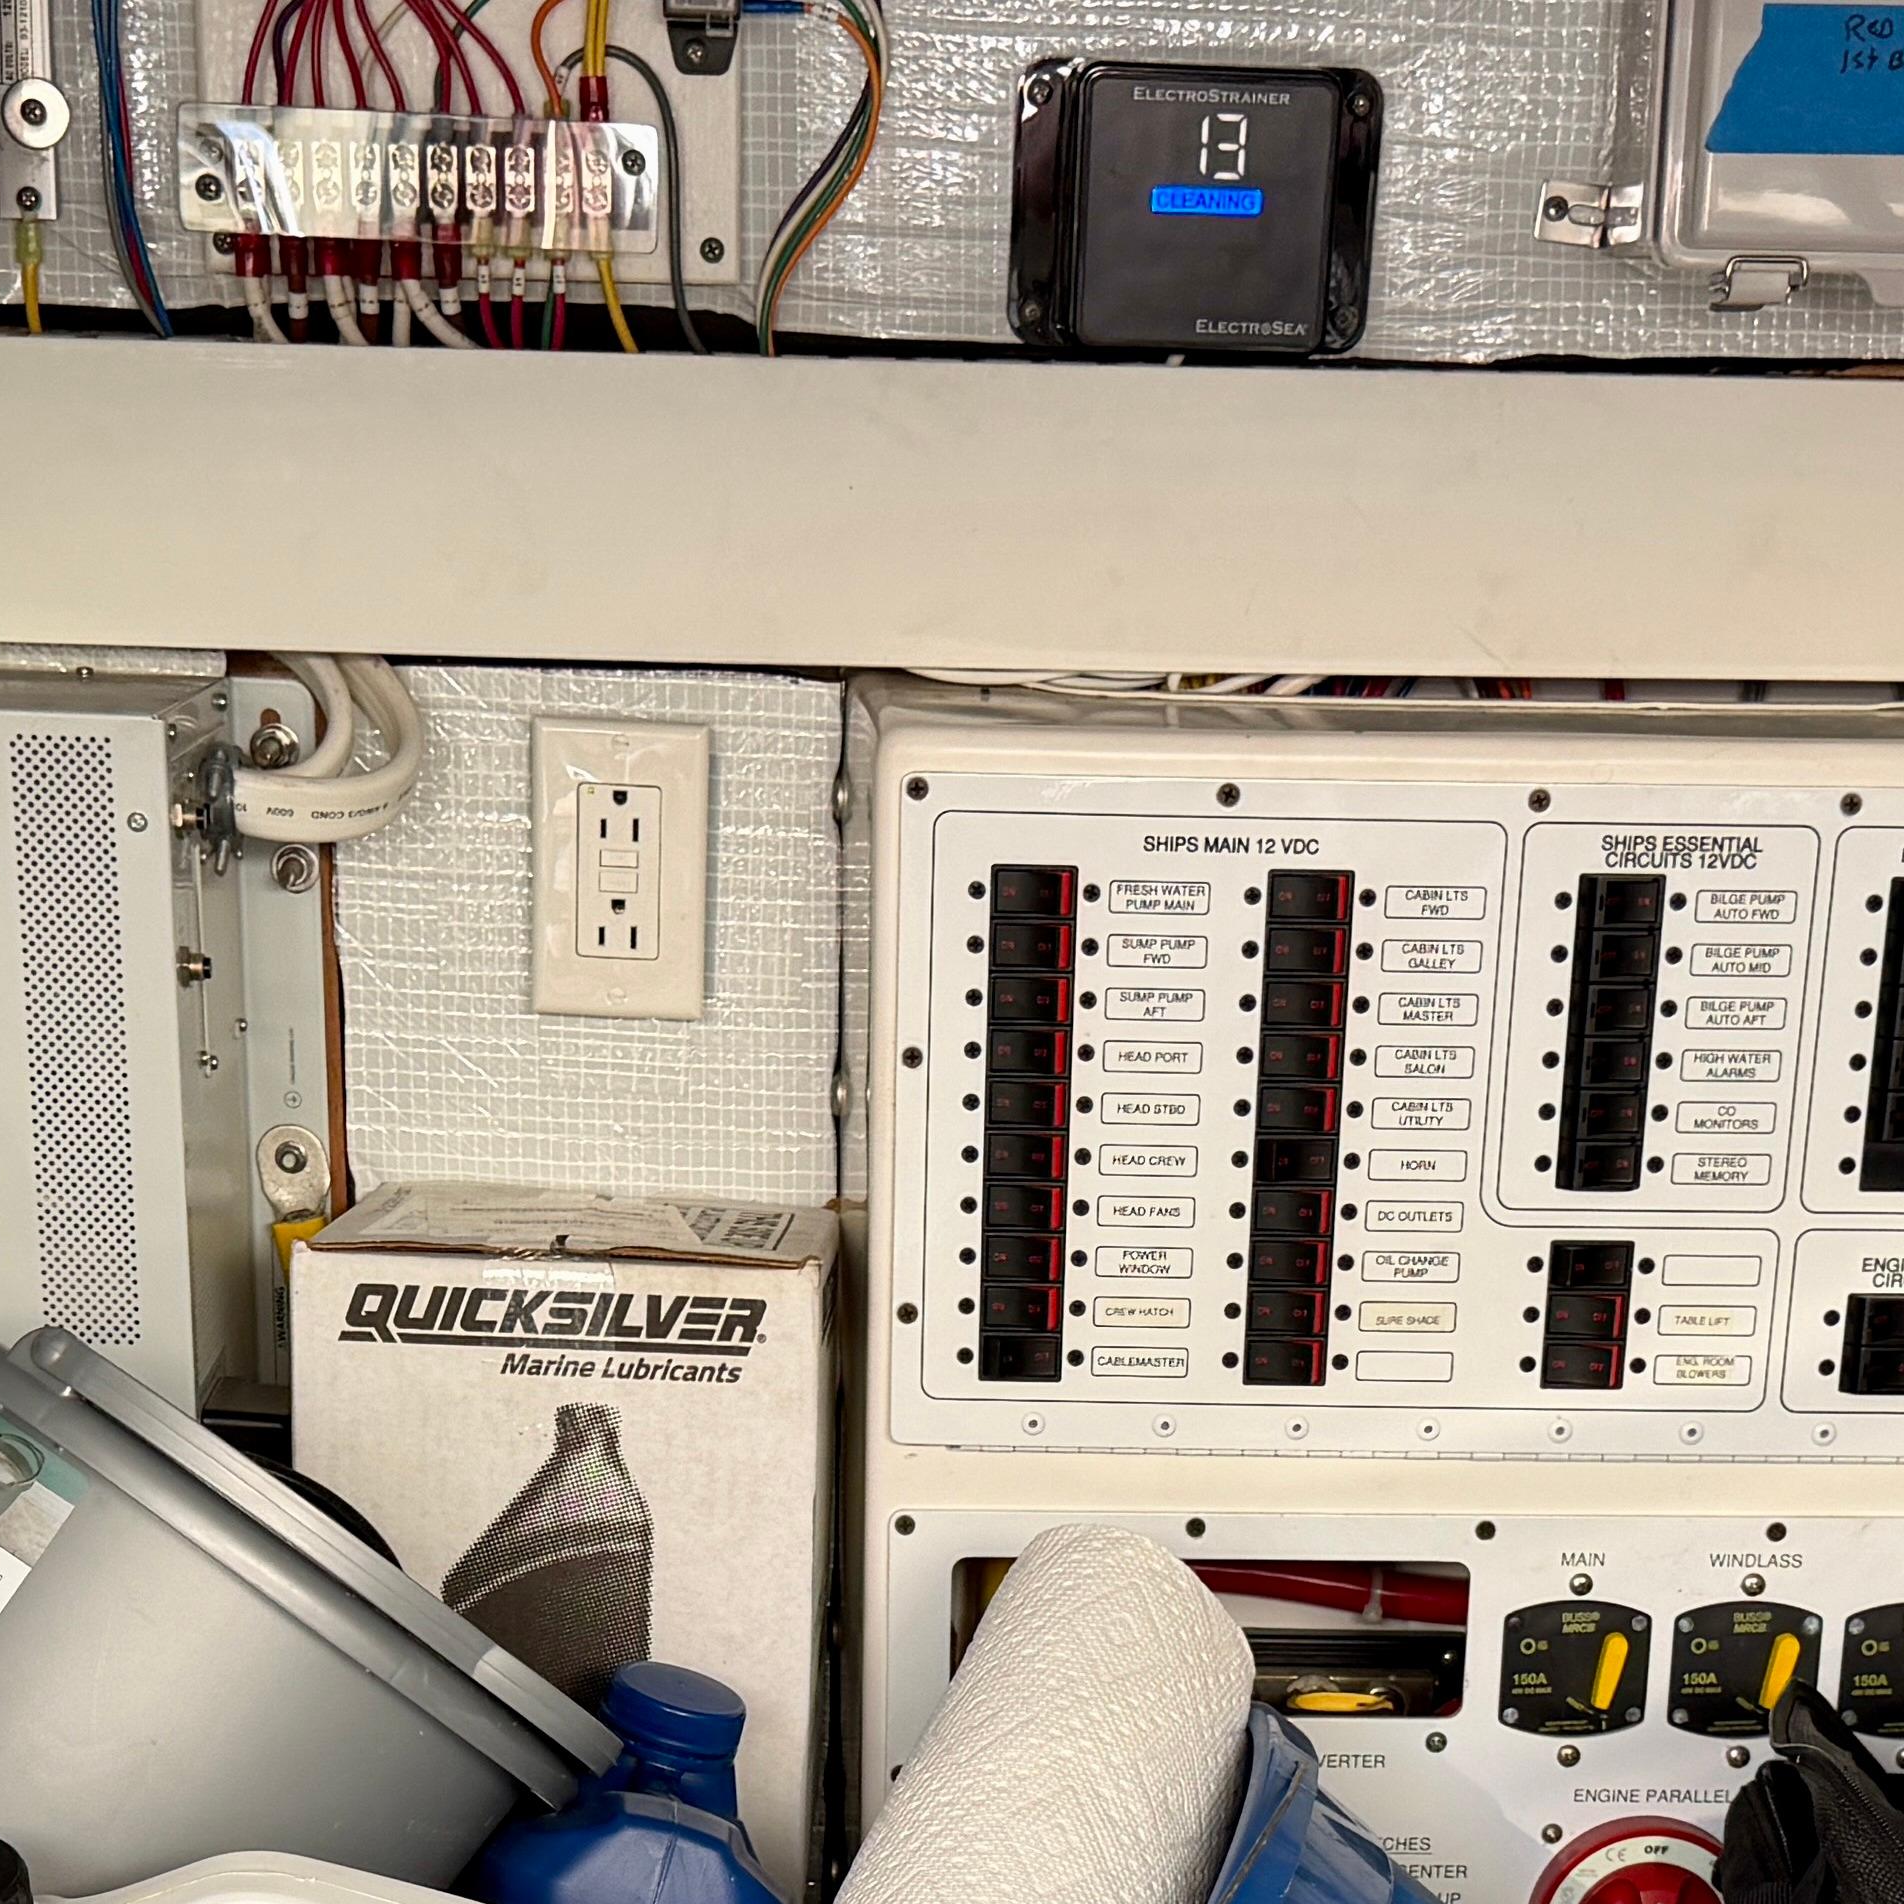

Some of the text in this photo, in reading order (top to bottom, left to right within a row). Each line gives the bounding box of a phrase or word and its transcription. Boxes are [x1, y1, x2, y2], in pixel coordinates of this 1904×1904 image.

[1199, 113, 1249, 180] 13
[1155, 192, 1256, 211] CLEANING
[1144, 836, 1320, 856] SHIPS MAIN 12 VDC
[1601, 834, 1763, 854] SHIPS ESSENTIAL
[1605, 852, 1757, 870] CIRCUITS 12VDC
[1116, 884, 1206, 898] FRESH WATER
[1126, 898, 1196, 912] PUMP MAIN
[1710, 893, 1785, 907] BILGE PUMP
[1420, 903, 1449, 916] FWD
[1713, 907, 1780, 921] AUTO FWD
[1142, 952, 1172, 966] FWD
[1705, 946, 1780, 961] BILGE PUMP
[1711, 961, 1771, 975] AUTO MID
[1118, 1050, 1188, 1064] HEAD PORT
[1694, 1052, 1772, 1067] HIGH WATER
[342, 1283, 768, 1345] QUICKSILVER
[500, 1353, 743, 1384] Marine Lubricants
[1560, 1552, 1606, 1568] MAIN
[1710, 1553, 1803, 1569] WINDLASS
[1512, 1673, 1547, 1686] 150A
[1682, 1673, 1717, 1686] 150A
[1853, 1674, 1888, 1687] 150A
[1317, 1754, 1386, 1770] VERTER
[1574, 1788, 1733, 1804] ENGINE PARALLEL
[1380, 1836, 1431, 1852] CHES
[1644, 1845, 1669, 1856] OFF
